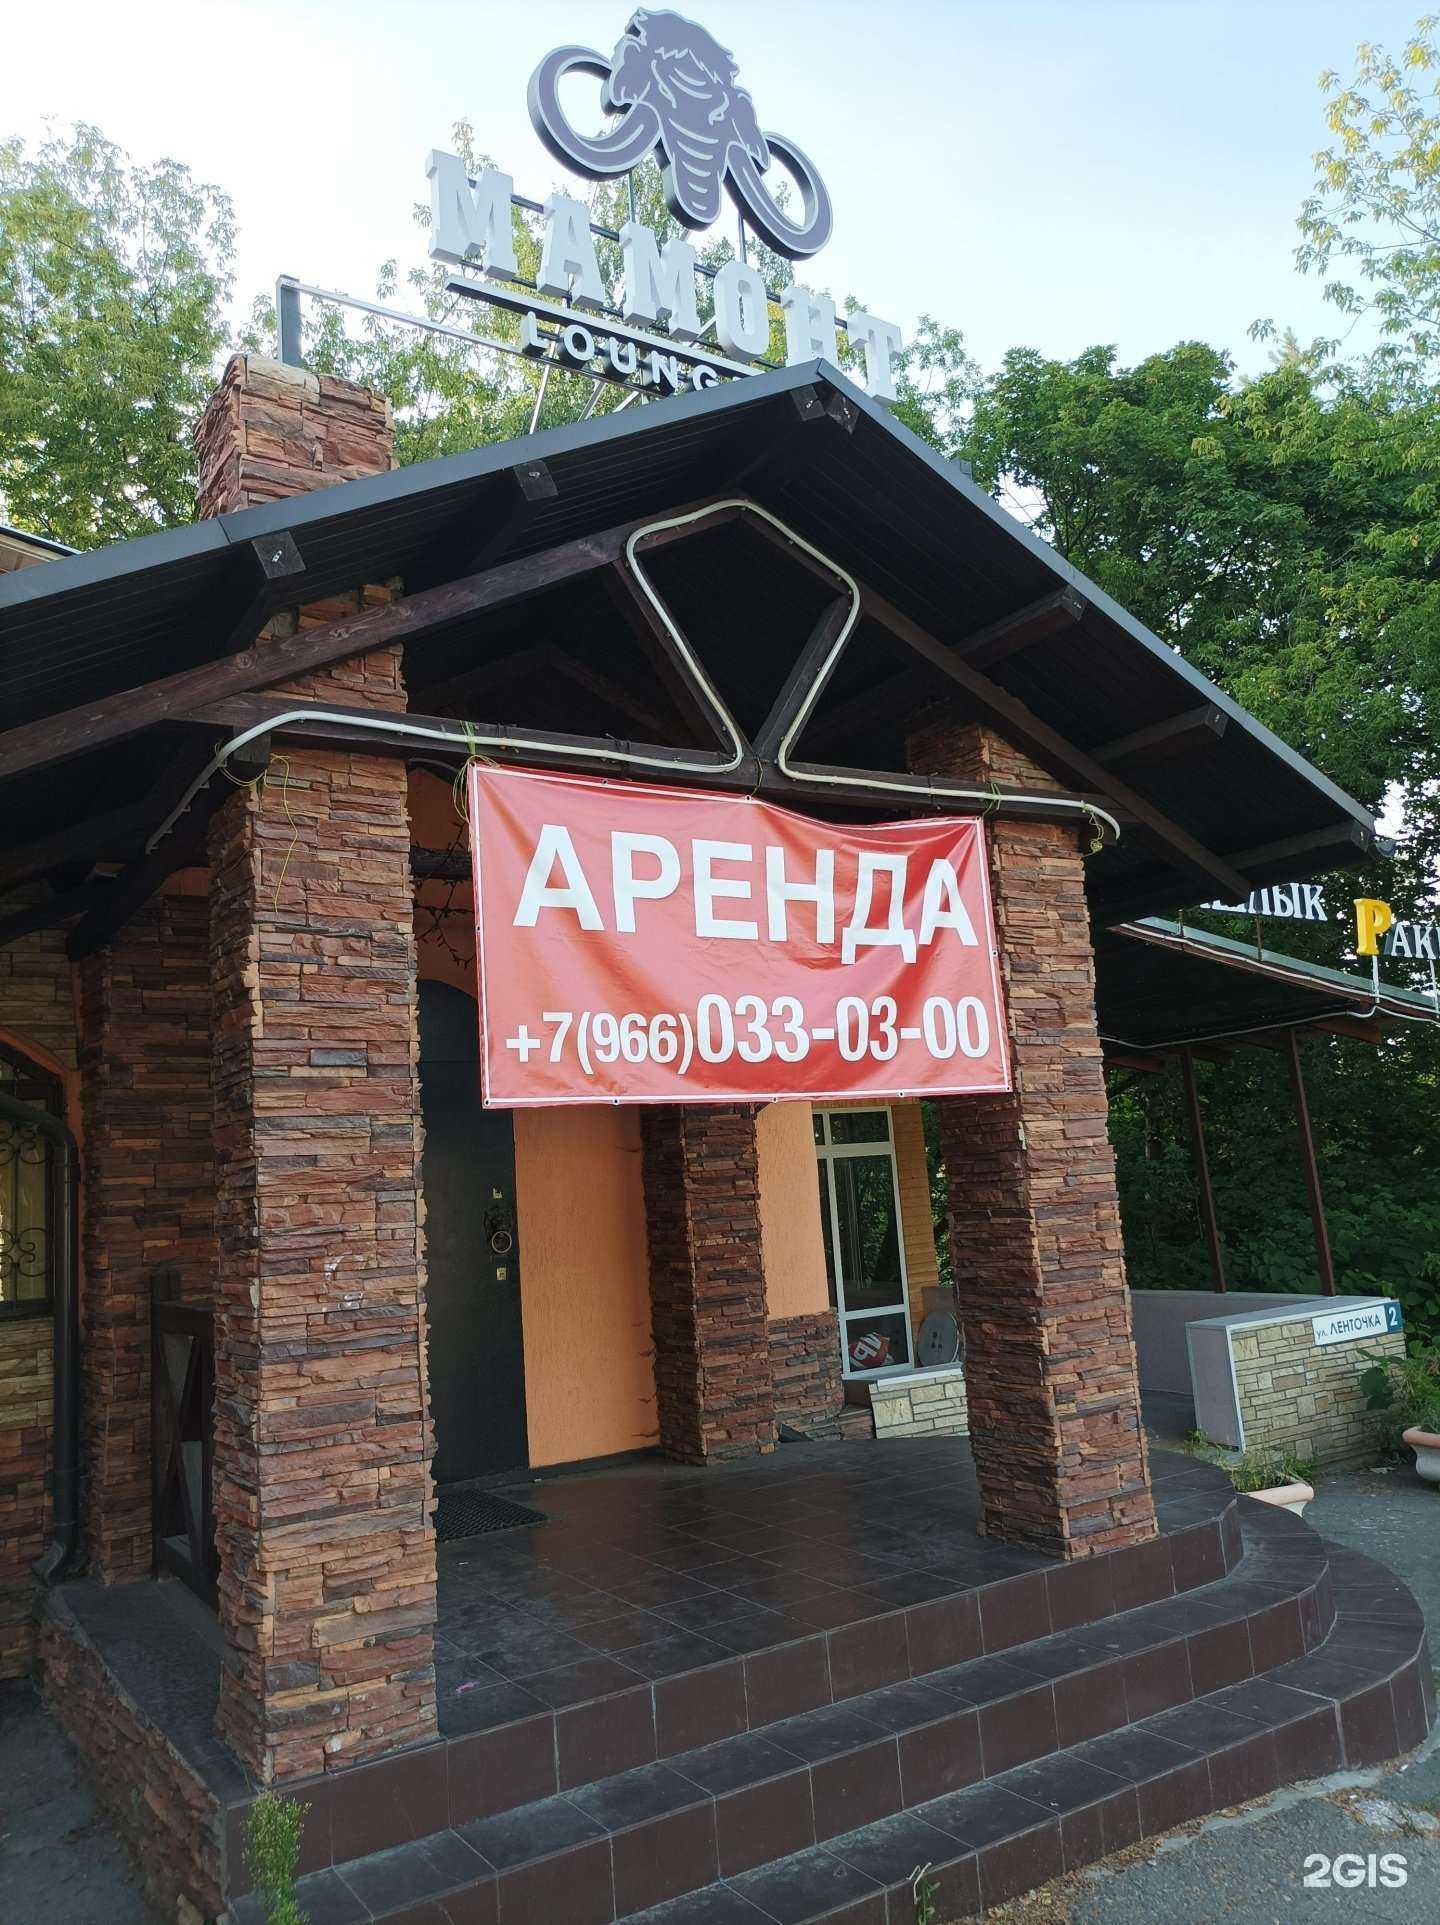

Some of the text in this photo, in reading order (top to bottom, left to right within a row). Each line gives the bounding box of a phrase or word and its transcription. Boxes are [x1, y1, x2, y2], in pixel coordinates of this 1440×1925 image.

[427, 148, 902, 402] МАМОНТ
[521, 311, 743, 396] LOUNG
[513, 823, 979, 965] АРЕНДА
[506, 993, 990, 1075] +7(966)033-03-00
[1330, 1313, 1382, 1335] ЛЕНТОЧКА
[1388, 1306, 1399, 1326] 2
